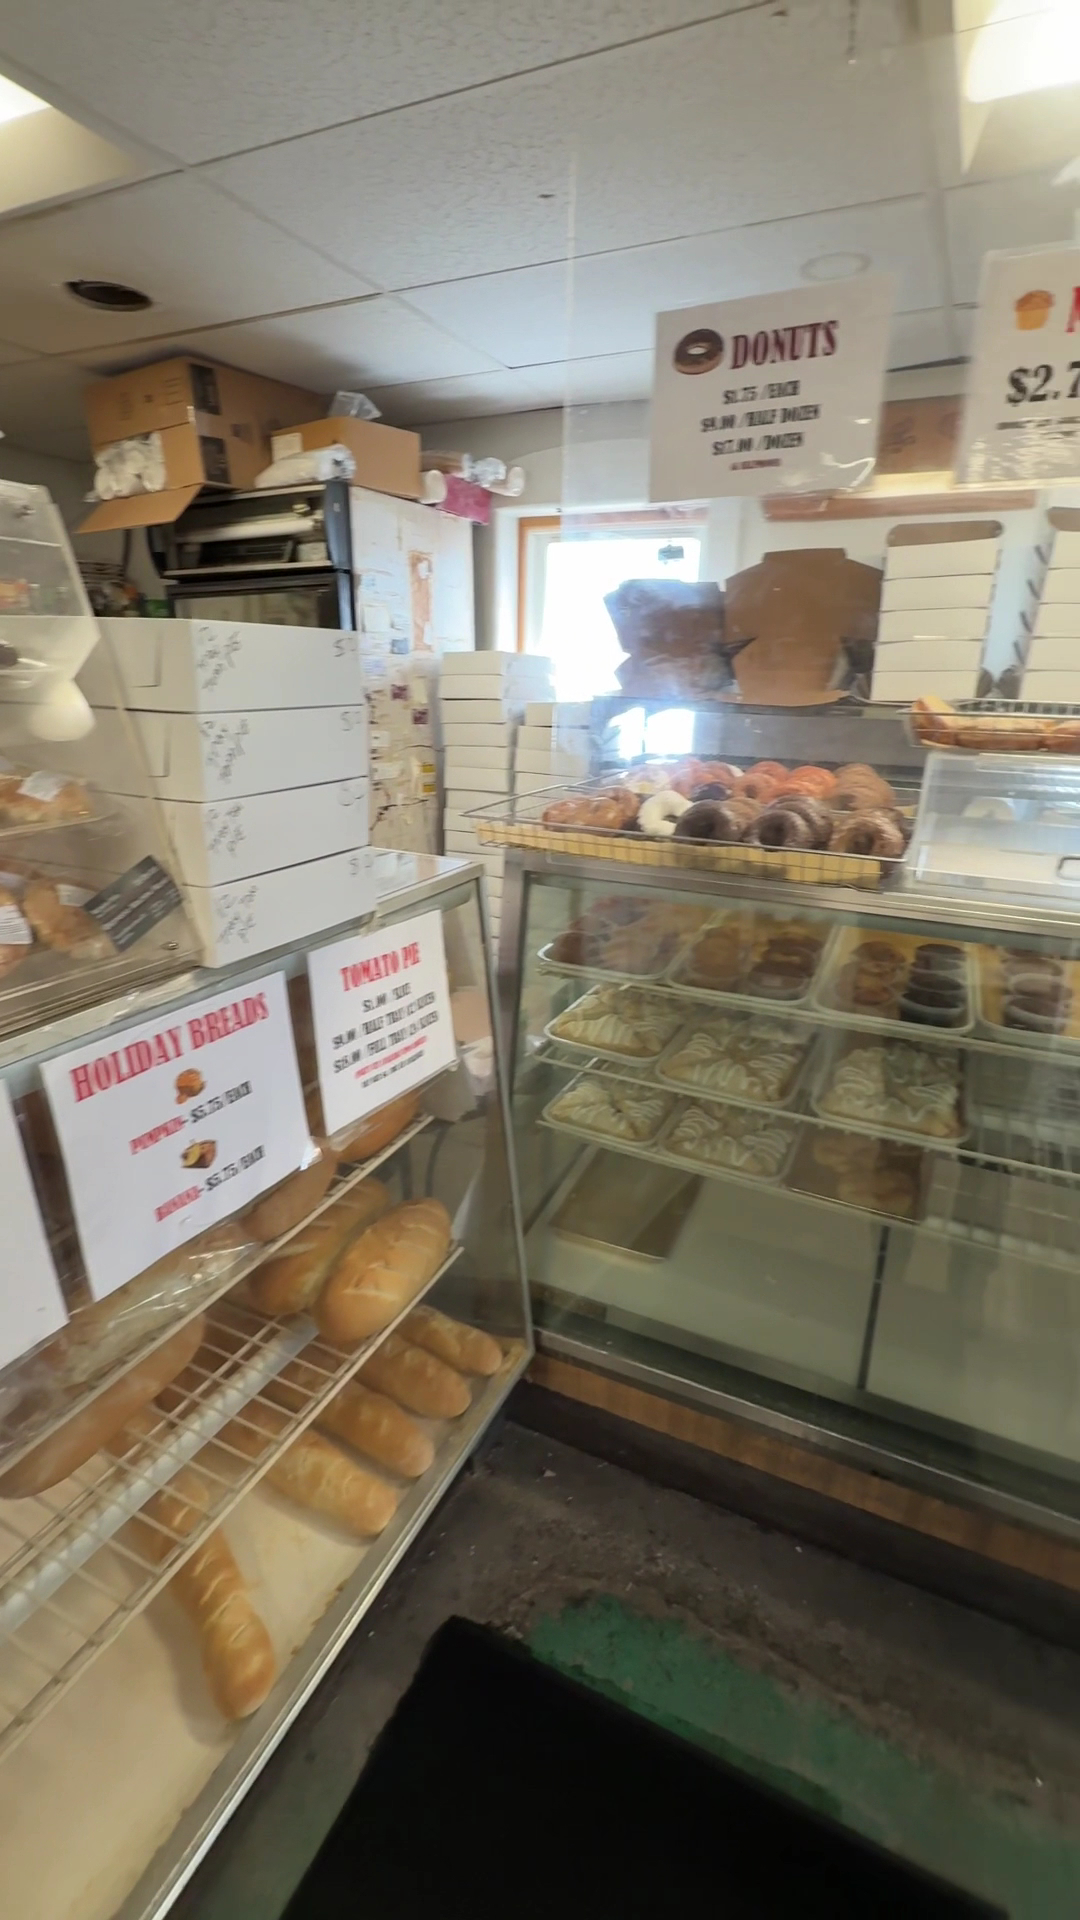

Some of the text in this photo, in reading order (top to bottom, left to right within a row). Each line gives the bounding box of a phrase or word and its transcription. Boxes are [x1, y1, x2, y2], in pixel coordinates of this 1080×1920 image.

[730, 320, 839, 369] DONUTS
[339, 951, 400, 991] TOMATO
[69, 992, 270, 1103] HOLIDAY BREADS
